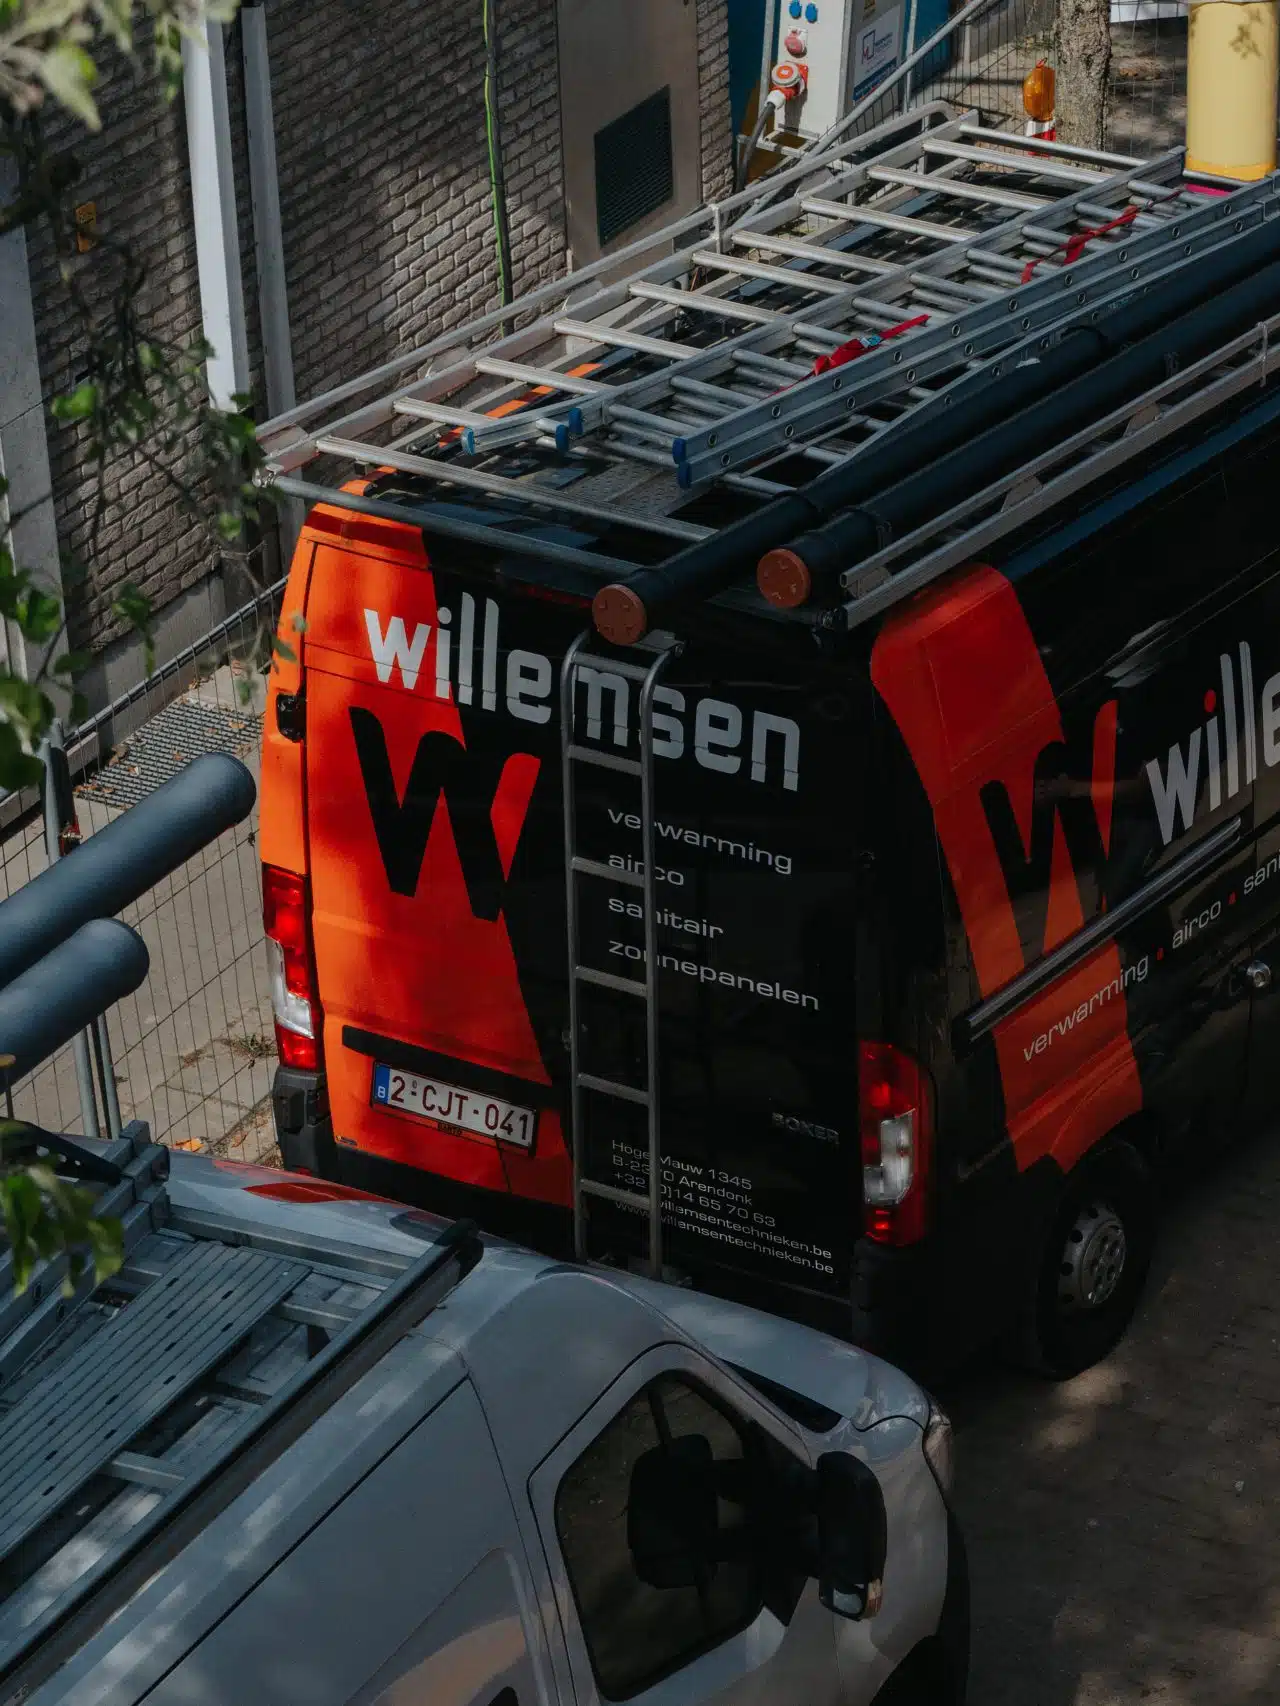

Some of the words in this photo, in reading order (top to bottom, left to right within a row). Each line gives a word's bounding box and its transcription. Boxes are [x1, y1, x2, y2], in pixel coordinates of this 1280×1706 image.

[362, 590, 800, 795] willemsen
[608, 807, 793, 876] vewarming
[1022, 954, 1149, 1062] verwarming
[1171, 901, 1222, 950] airco
[377, 1085, 387, 1099] B
[390, 1075, 530, 1142] 2-CJT-041
[611, 1139, 651, 1161] Hoge
[707, 1168, 753, 1191] 1345
[611, 1154, 675, 1183] B-230
[679, 1175, 754, 1207] Arendonk
[612, 1171, 648, 1190] +32
[658, 1182, 694, 1204] 0)14
[698, 1195, 722, 1212] 65
[727, 1202, 750, 1220] 70
[752, 1211, 777, 1229] 63
